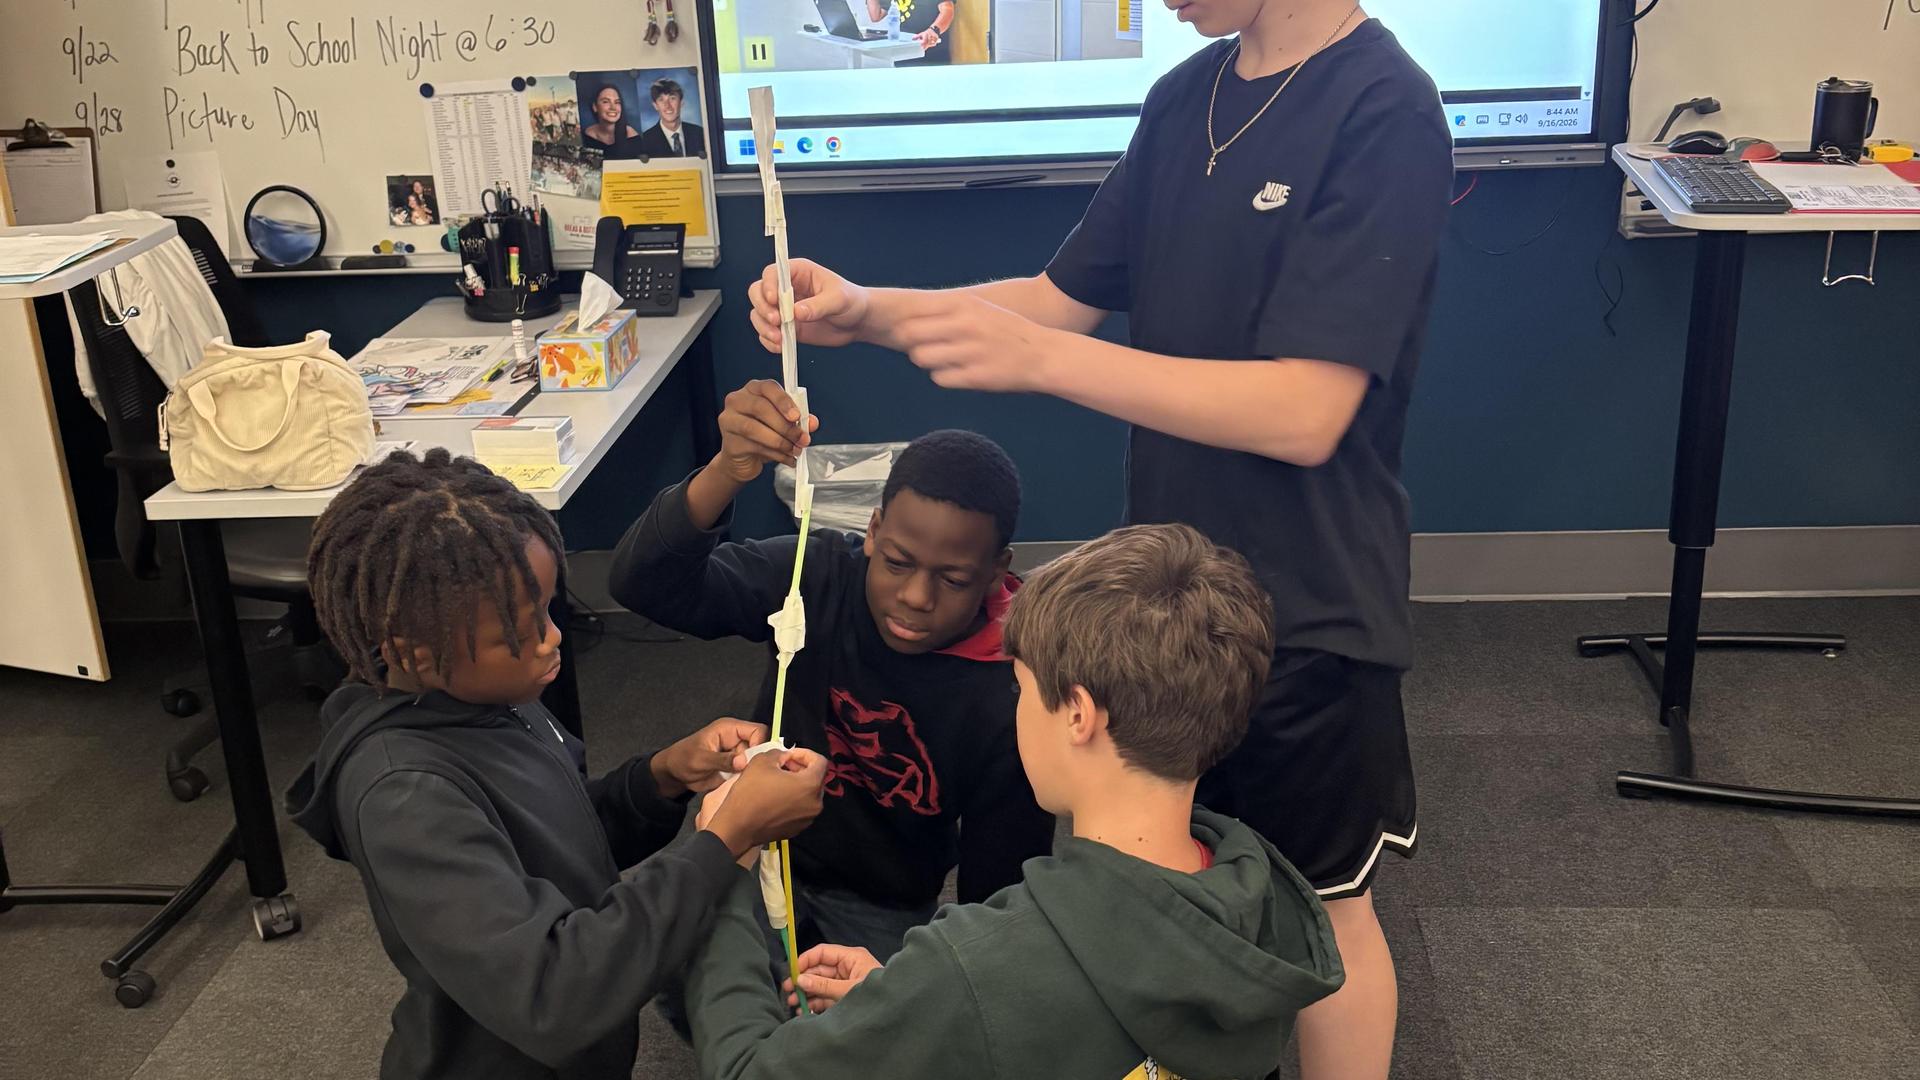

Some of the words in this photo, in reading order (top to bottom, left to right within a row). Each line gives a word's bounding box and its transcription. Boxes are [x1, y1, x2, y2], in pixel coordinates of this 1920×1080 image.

[62, 25, 119, 84] 9/22
[173, 25, 240, 76] Back
[247, 32, 269, 67] to
[287, 16, 357, 68] School
[376, 15, 447, 80] Night
[456, 30, 478, 62] @
[485, 14, 555, 51] 6:30
[75, 91, 124, 150] 9/28
[163, 86, 254, 150] Picture
[273, 86, 325, 163] Day
[1538, 119, 1578, 127] 9/16/2026
[1261, 181, 1292, 202] NIKE
